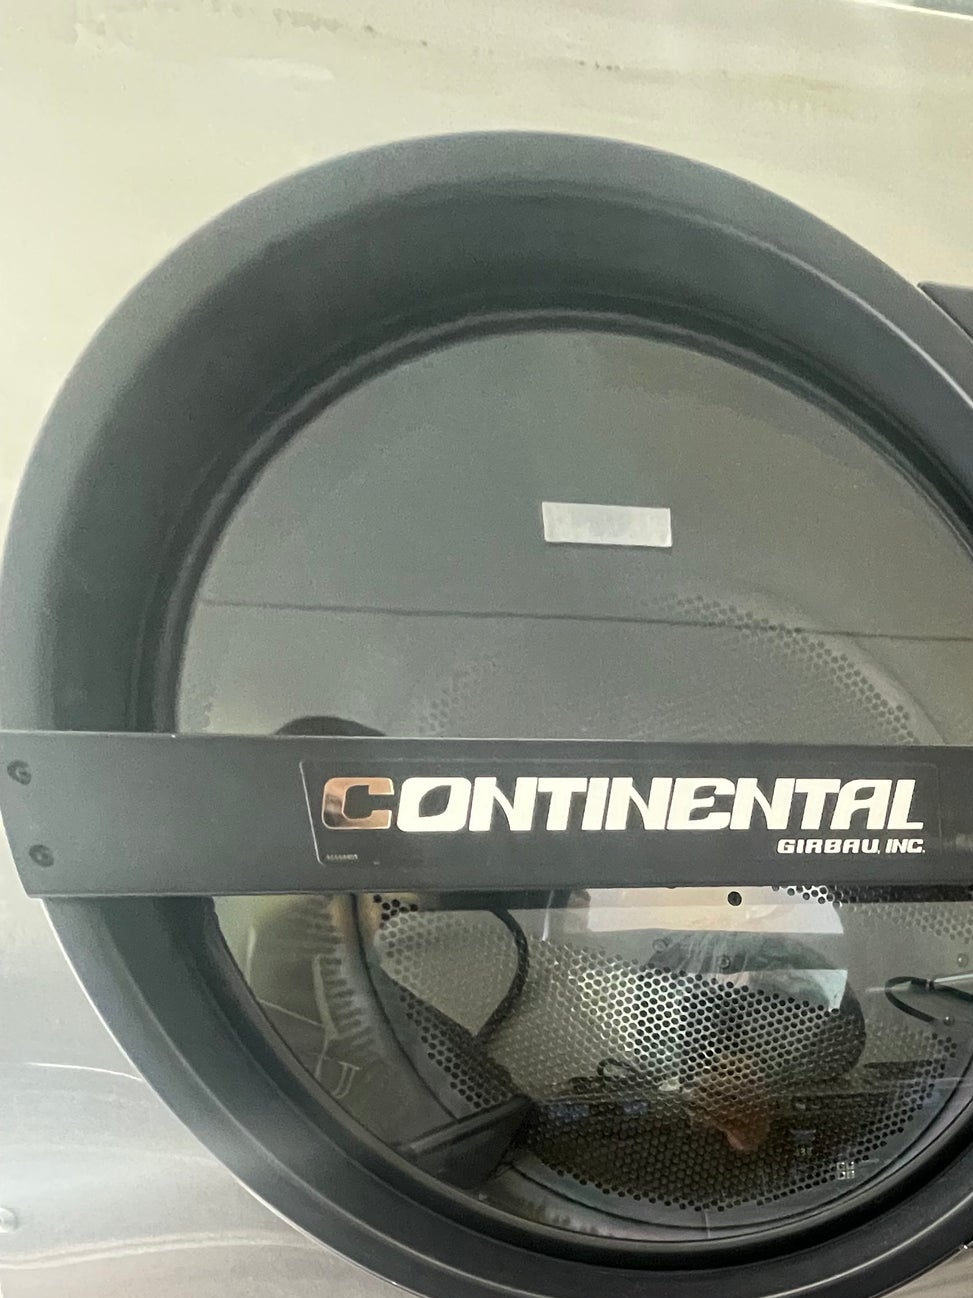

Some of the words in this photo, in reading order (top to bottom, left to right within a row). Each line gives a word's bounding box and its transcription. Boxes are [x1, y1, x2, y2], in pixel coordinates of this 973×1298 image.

[322, 776, 925, 832] CONTINENTAL
[777, 838, 880, 854] GIRBAU,
[885, 838, 926, 854] INC.
